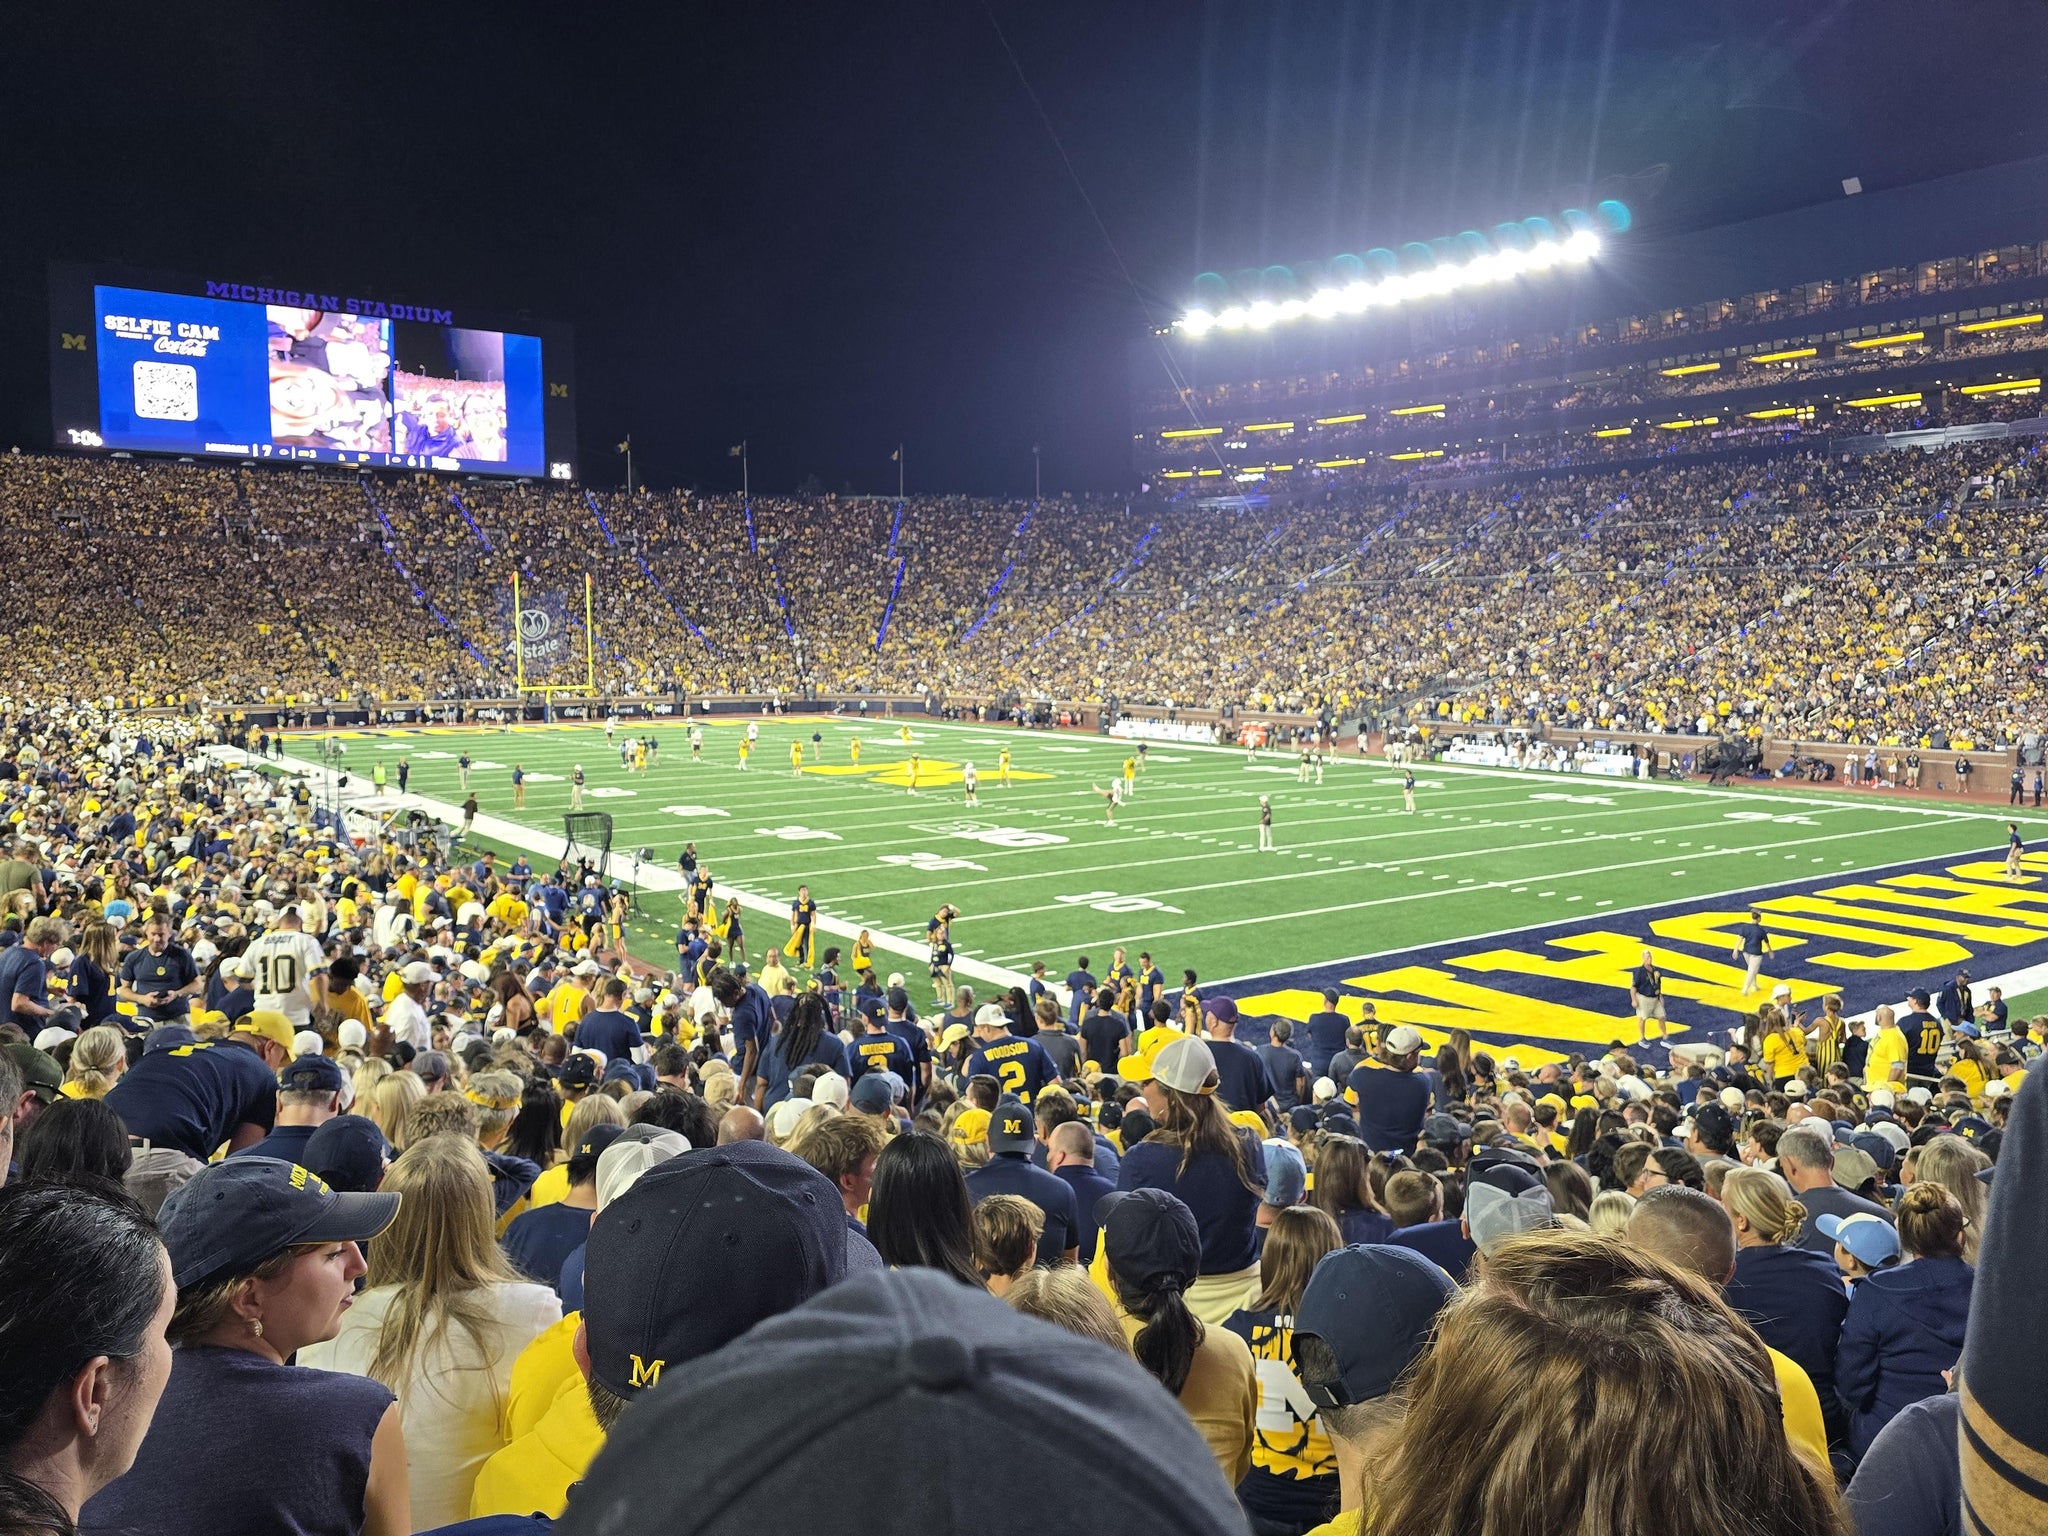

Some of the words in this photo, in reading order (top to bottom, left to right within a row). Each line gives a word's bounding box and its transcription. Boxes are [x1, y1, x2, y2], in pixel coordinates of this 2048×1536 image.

[206, 280, 340, 312] MICHIGAN
[345, 298, 453, 325] STADIUM
[104, 315, 171, 336] SELFIE
[178, 323, 220, 341] CAM
[61, 333, 87, 350] M
[550, 383, 568, 397] M
[1053, 890, 1164, 913] 10
[258, 955, 296, 995] 10
[984, 1042, 1029, 1062] WOODSON
[1917, 1028, 1941, 1055] 10
[998, 1060, 1031, 1105] 2
[1003, 1119, 1022, 1134] M
[581, 1144, 592, 1154] M
[628, 1353, 666, 1390] M
